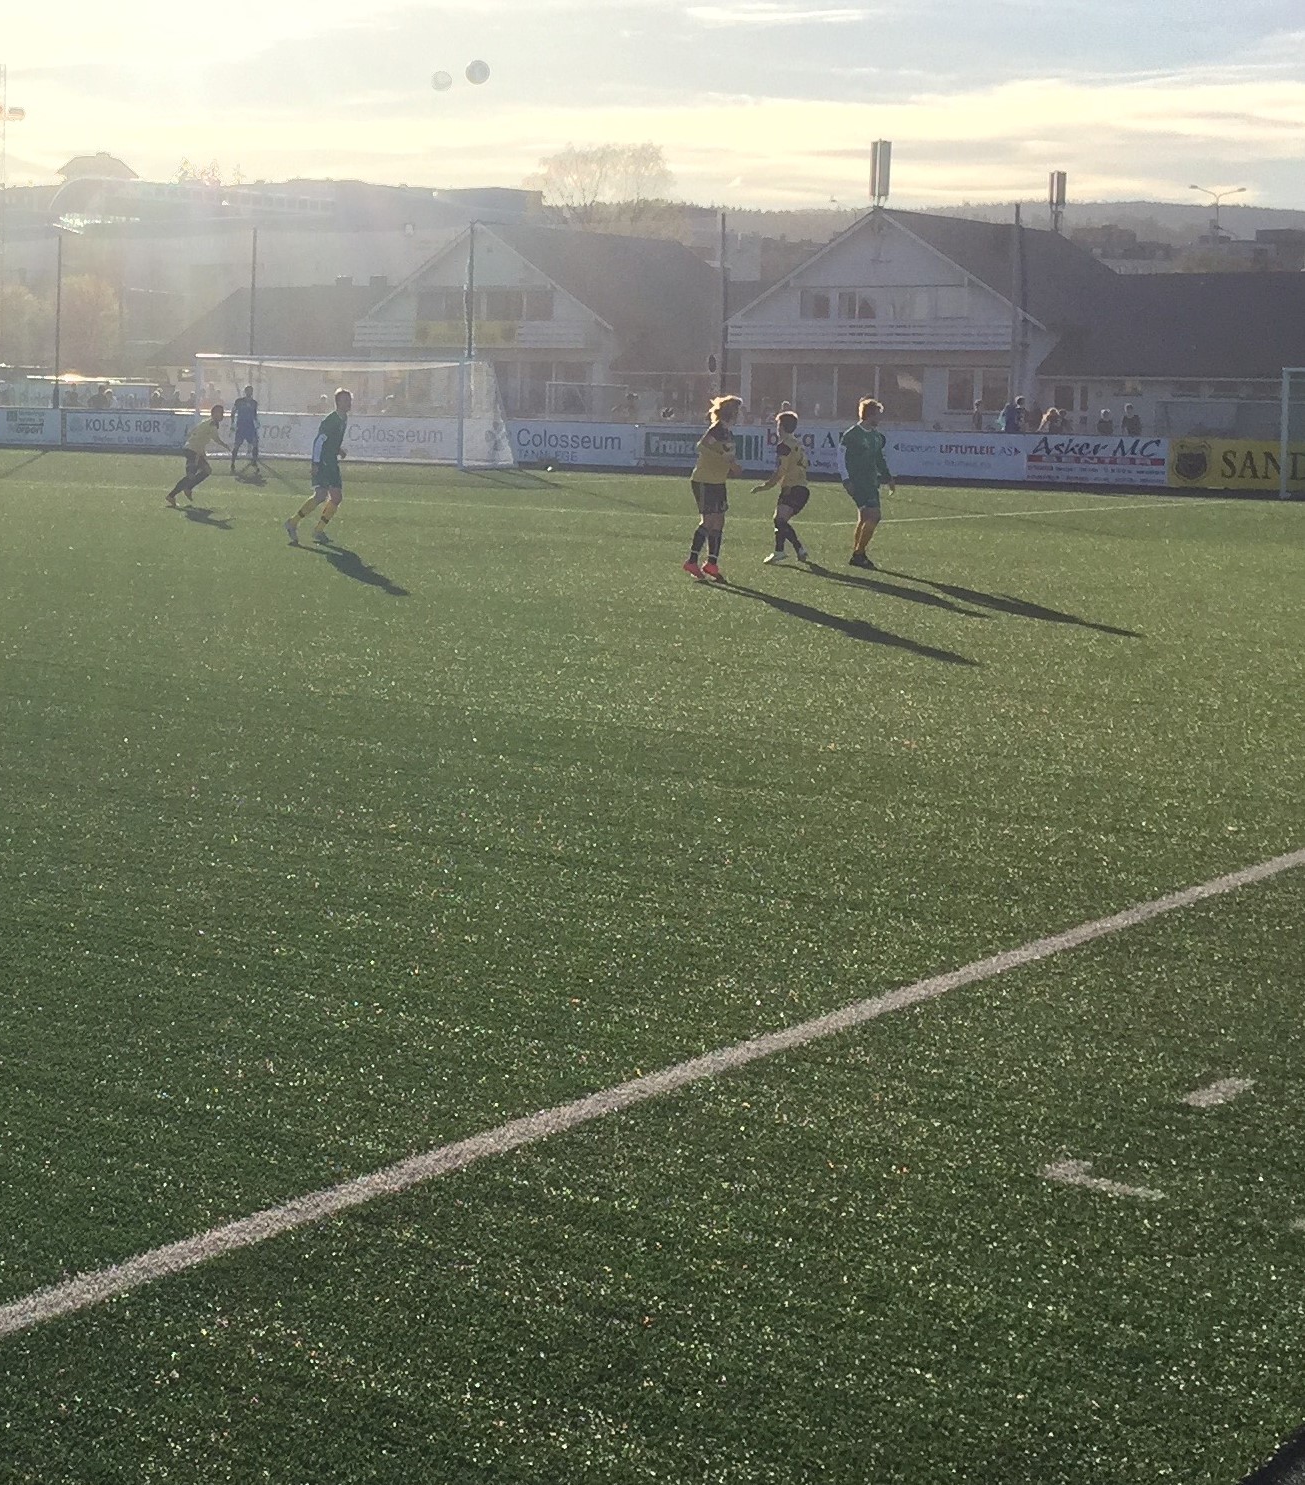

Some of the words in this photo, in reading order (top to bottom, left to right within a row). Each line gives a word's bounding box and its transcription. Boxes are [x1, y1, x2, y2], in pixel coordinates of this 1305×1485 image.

[85, 416, 131, 432] KOLSÅS
[135, 419, 161, 433] RØR
[348, 423, 443, 444] Colosseum
[516, 428, 622, 450] Colosseum
[1032, 436, 1109, 456] Asker
[1112, 438, 1161, 457] MC
